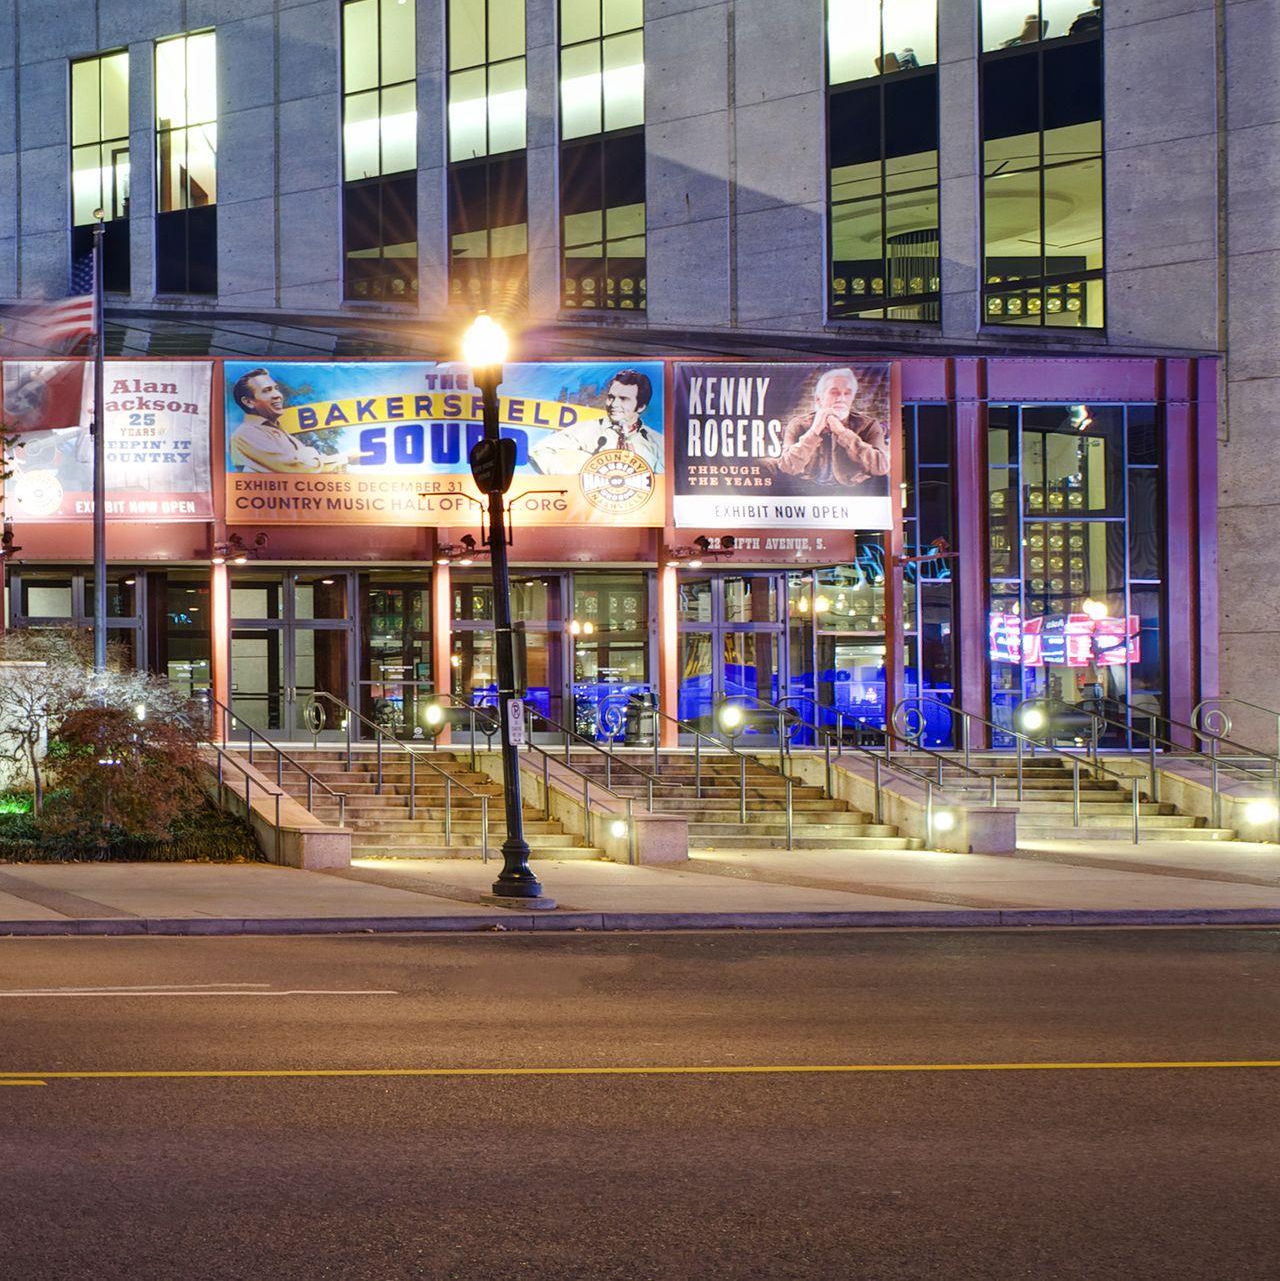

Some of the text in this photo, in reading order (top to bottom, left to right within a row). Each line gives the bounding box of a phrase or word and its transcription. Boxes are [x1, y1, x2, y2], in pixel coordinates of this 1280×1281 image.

[110, 379, 178, 394] Alan
[425, 374, 468, 390] THE
[689, 377, 771, 416] KENNY
[88, 396, 199, 415] ackson
[128, 413, 156, 426] 25
[120, 428, 156, 437] YEARS
[688, 419, 783, 458] ROGERS
[106, 440, 192, 450] EEPIN' IT
[106, 452, 192, 463] OUNTRY
[688, 465, 761, 476] THROUGH
[235, 480, 463, 493] EXHIBIT CLOSES DECEMBER 31
[689, 476, 773, 487] THE YEARS
[75, 500, 196, 513] EXBIT NOW OPEN
[235, 496, 322, 510] COUNTRY
[327, 497, 385, 511] MUSIC
[391, 498, 435, 511] HALL
[440, 498, 464, 511] OF
[715, 505, 849, 519] EXHIBIT NOW OPEN
[733, 537, 760, 550] IFTH
[765, 538, 812, 551] AVENUE,
[816, 538, 827, 550] S.
